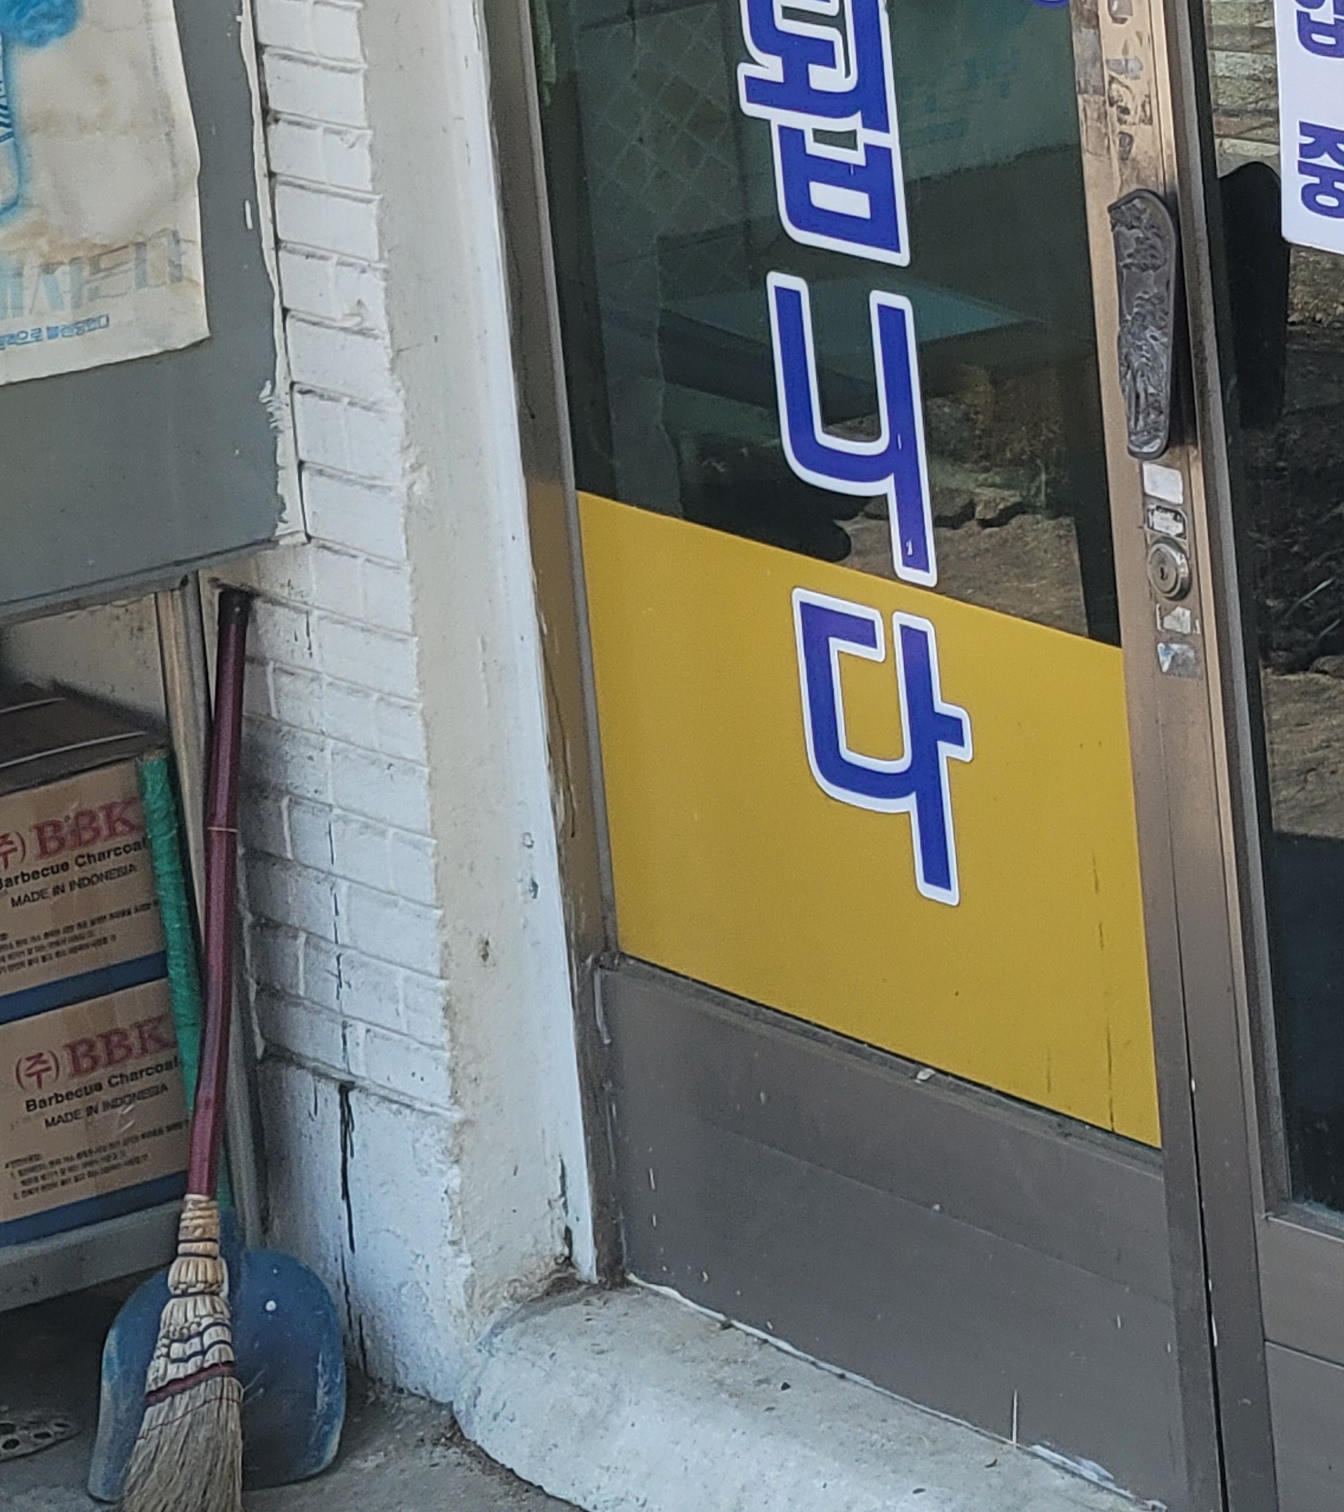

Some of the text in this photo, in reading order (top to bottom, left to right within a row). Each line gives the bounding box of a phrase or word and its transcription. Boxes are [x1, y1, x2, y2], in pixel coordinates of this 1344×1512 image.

[30, 796, 144, 861] BBK
[0, 862, 70, 889] arbecue
[11, 863, 137, 908] MADE IN INDONESIA
[15, 1013, 179, 1090] (주) BBK
[25, 1082, 104, 1113] Barbecue
[45, 1083, 168, 1129] MADE IN INDONESIA
